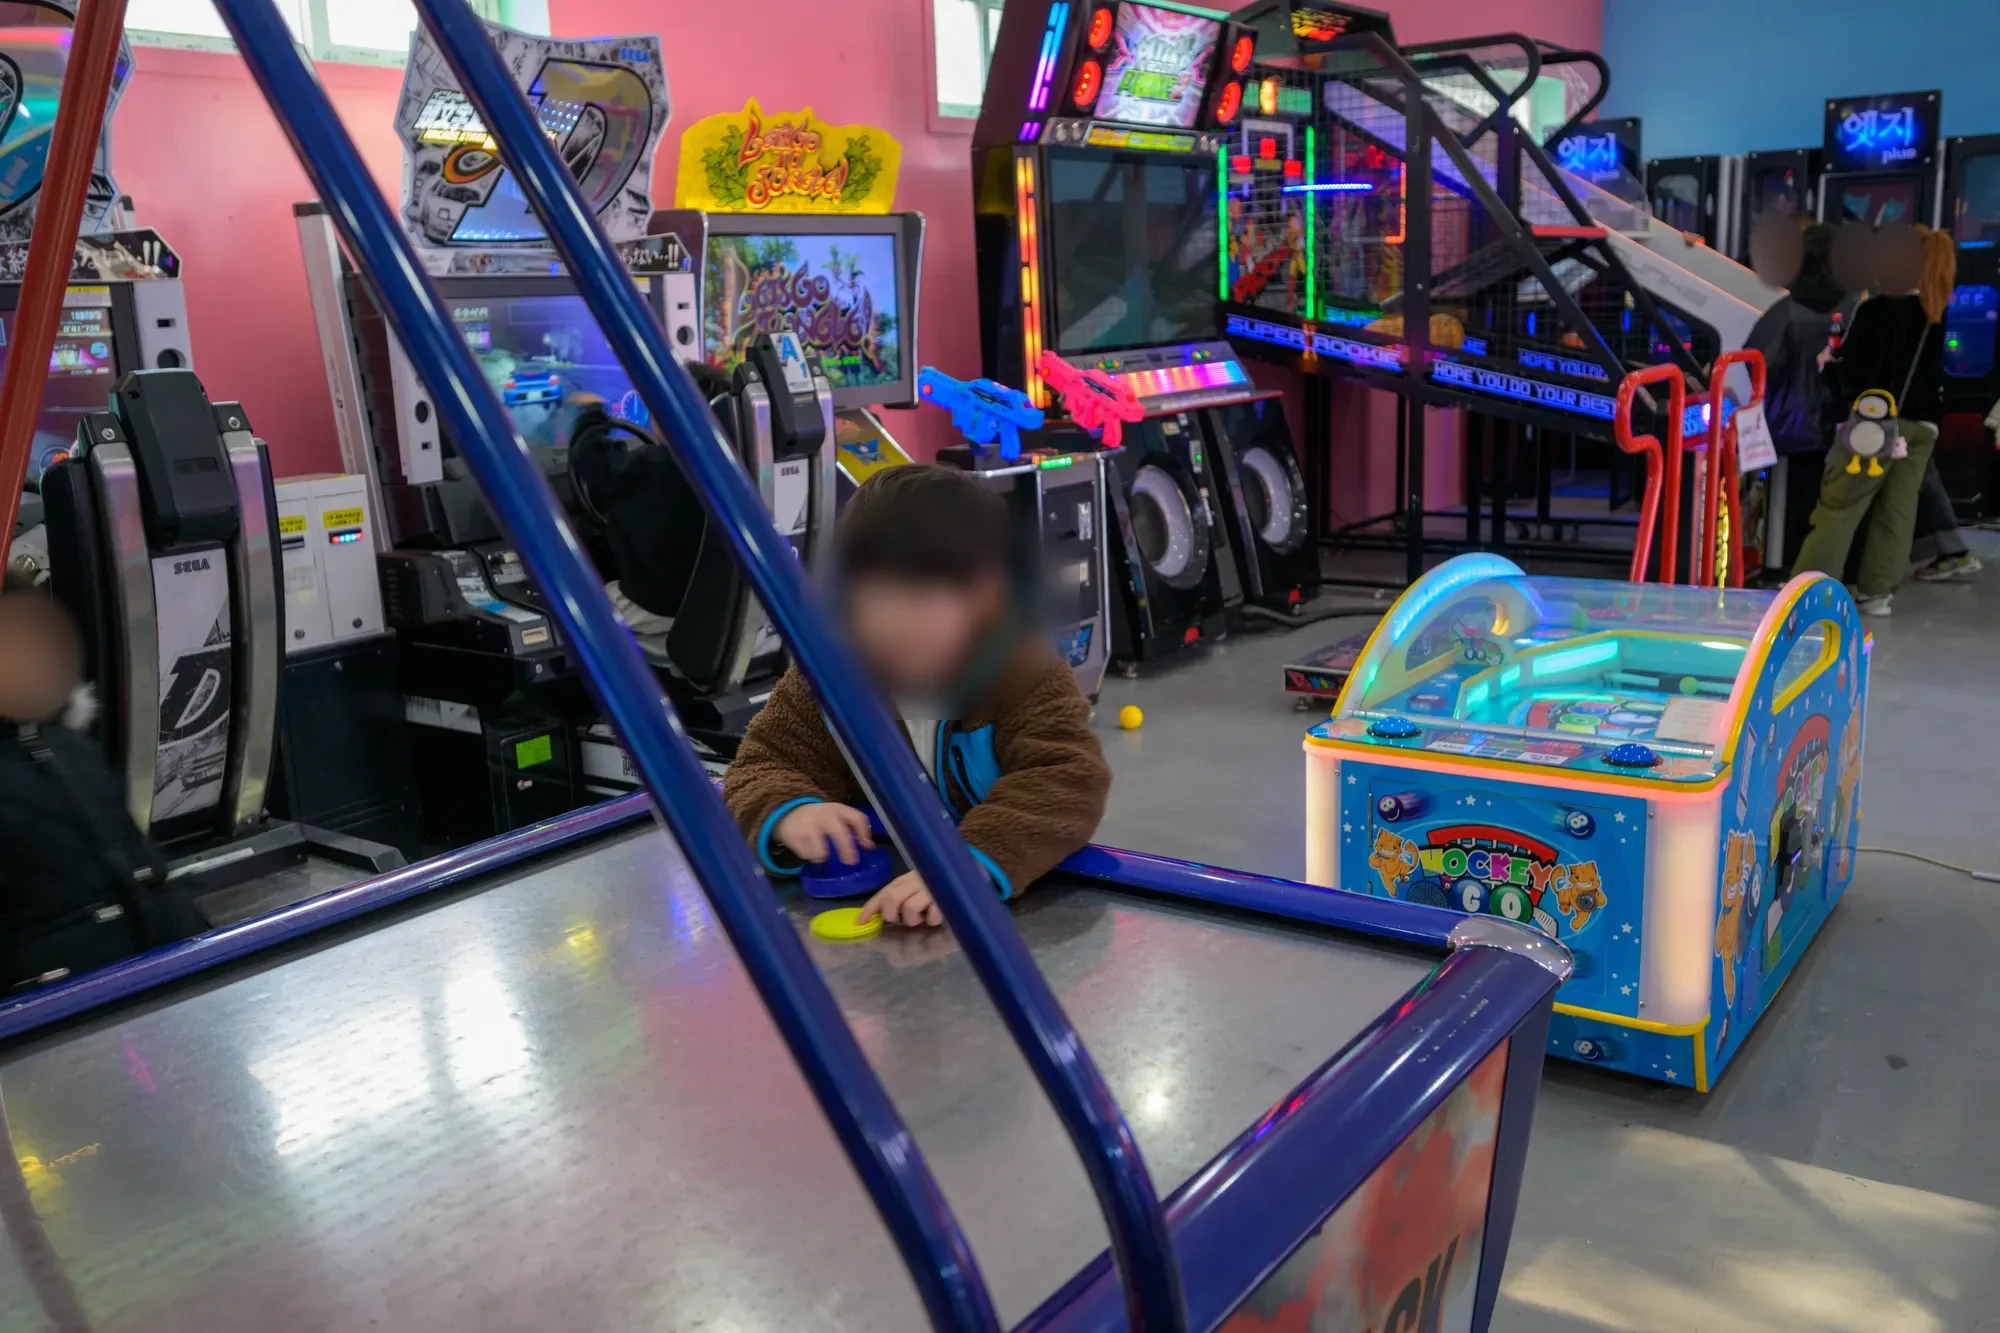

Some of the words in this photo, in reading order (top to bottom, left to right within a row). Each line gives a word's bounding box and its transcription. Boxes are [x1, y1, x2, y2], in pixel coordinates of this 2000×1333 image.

[1843, 107, 1914, 151] 엣지
[1557, 132, 1616, 170] 엣지
[1881, 146, 1917, 164] plus
[780, 335, 799, 361] A
[1227, 315, 1306, 346] SUPER
[1312, 335, 1402, 368] ROOKIE
[1434, 362, 1473, 384] HOPE
[1476, 371, 1507, 390] YOU
[1509, 379, 1532, 398] DO
[1534, 384, 1577, 406] YOUR
[1580, 395, 1617, 416] BEST
[173, 557, 211, 575] SEGA
[1418, 847, 1553, 892] HOCKEY
